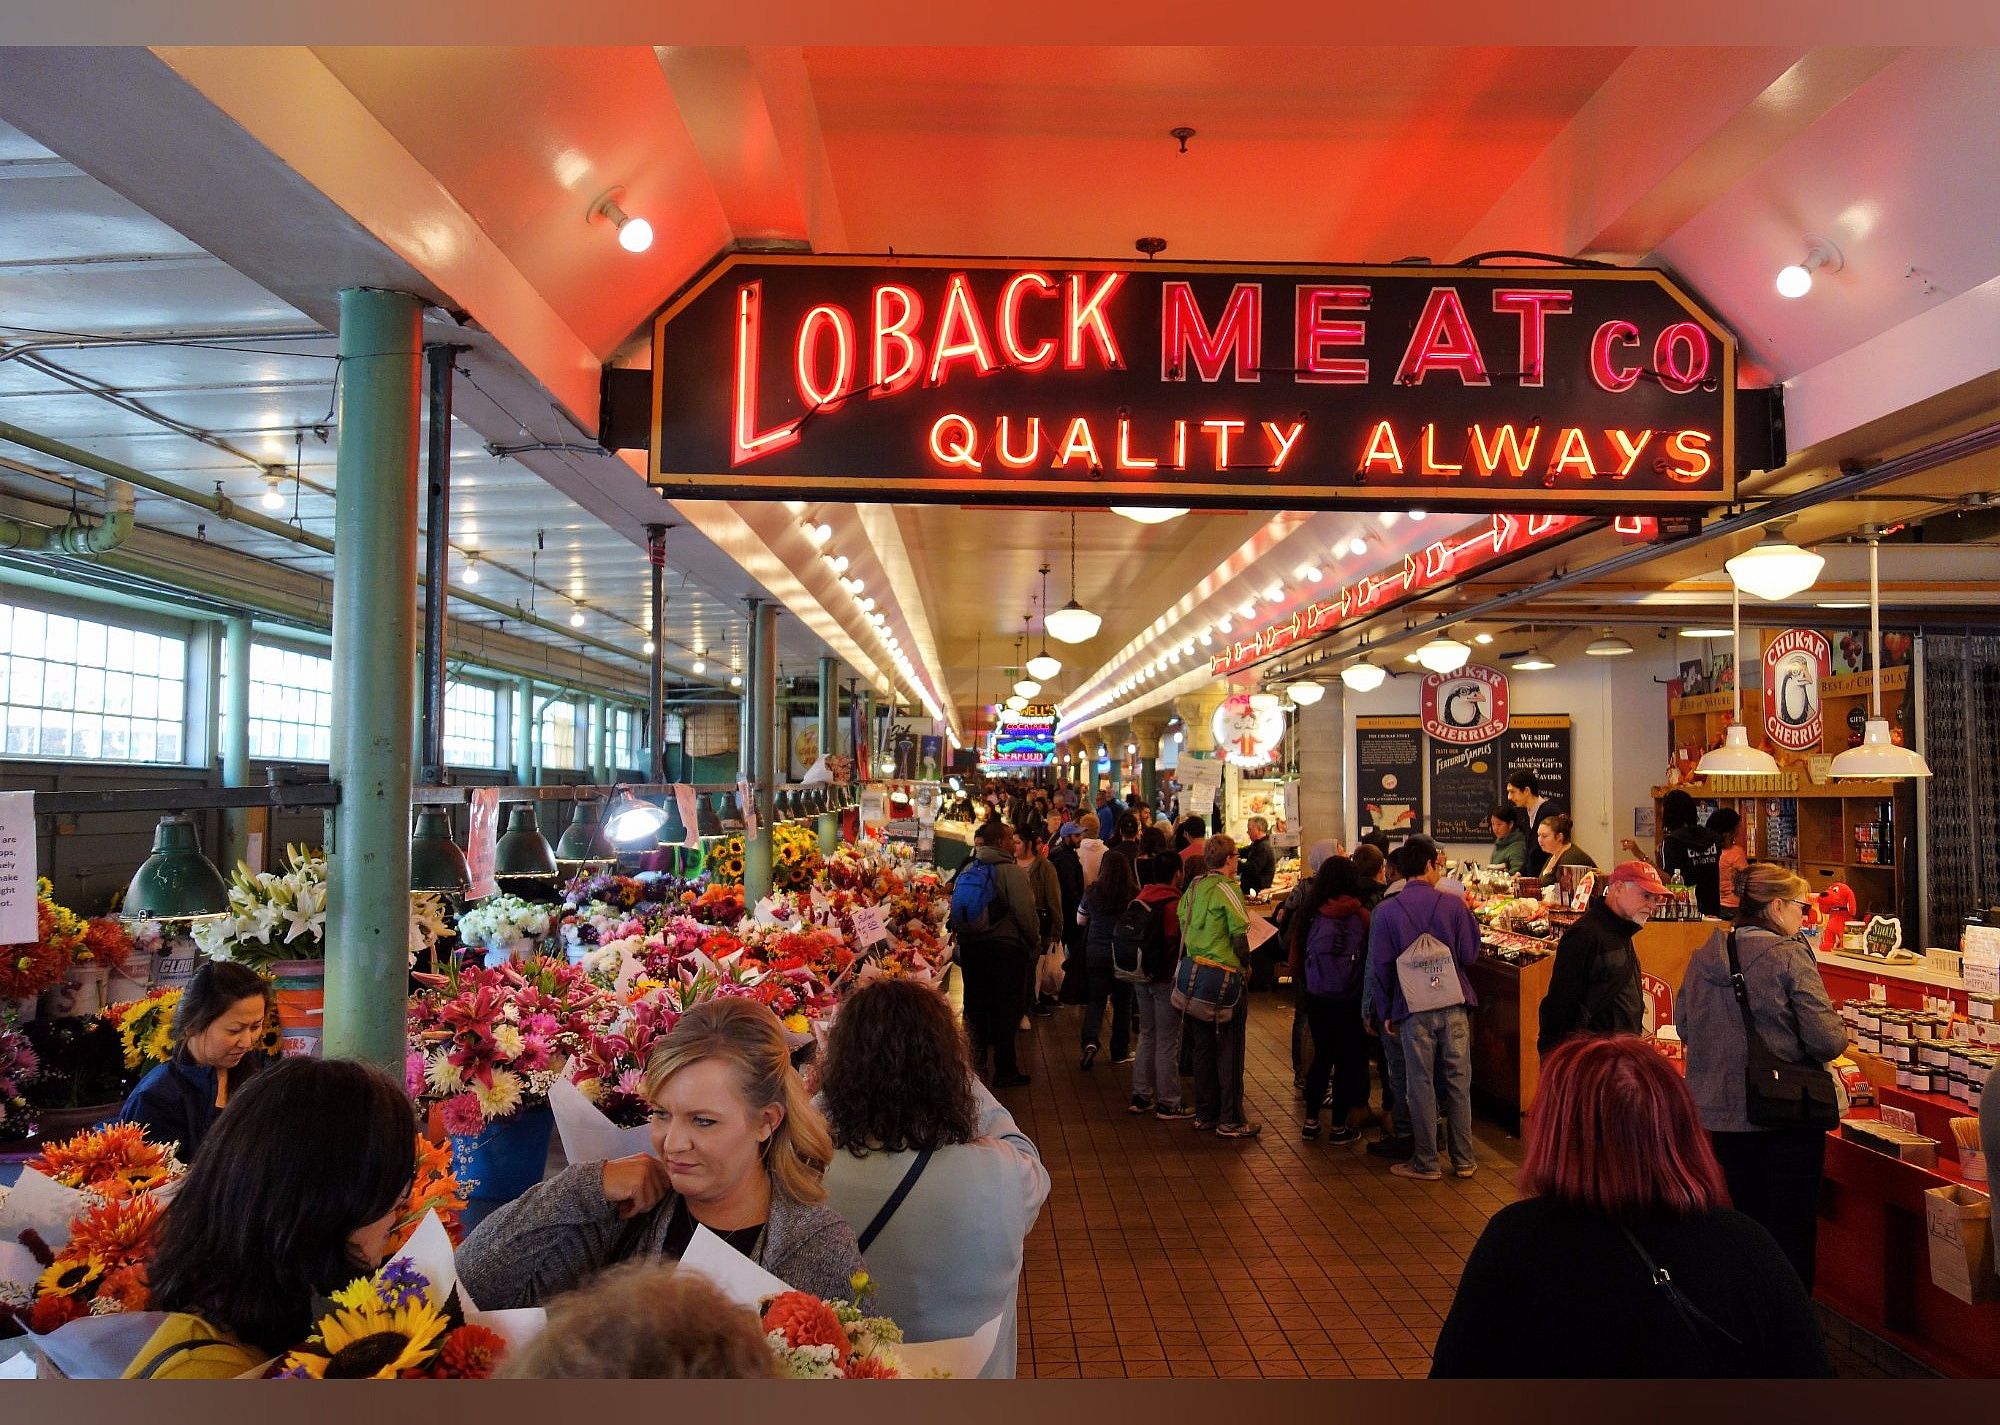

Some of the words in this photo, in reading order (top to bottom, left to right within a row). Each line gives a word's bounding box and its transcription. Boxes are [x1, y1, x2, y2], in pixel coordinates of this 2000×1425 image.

[1161, 282, 1573, 387] MEAT
[929, 414, 1306, 474] QUALITY
[1359, 420, 1711, 486] ALWAYS
[1767, 631, 1825, 666] CHUKAR
[1821, 679, 1843, 692] BEST
[1427, 719, 1505, 741] CHERRIES
[1520, 733, 1533, 741] WE
[1435, 753, 1466, 775] FEATURED
[1463, 743, 1492, 768] SAMPLES
[1541, 761, 1563, 769] GIFTS
[1749, 772, 1799, 793] CHERRIES
